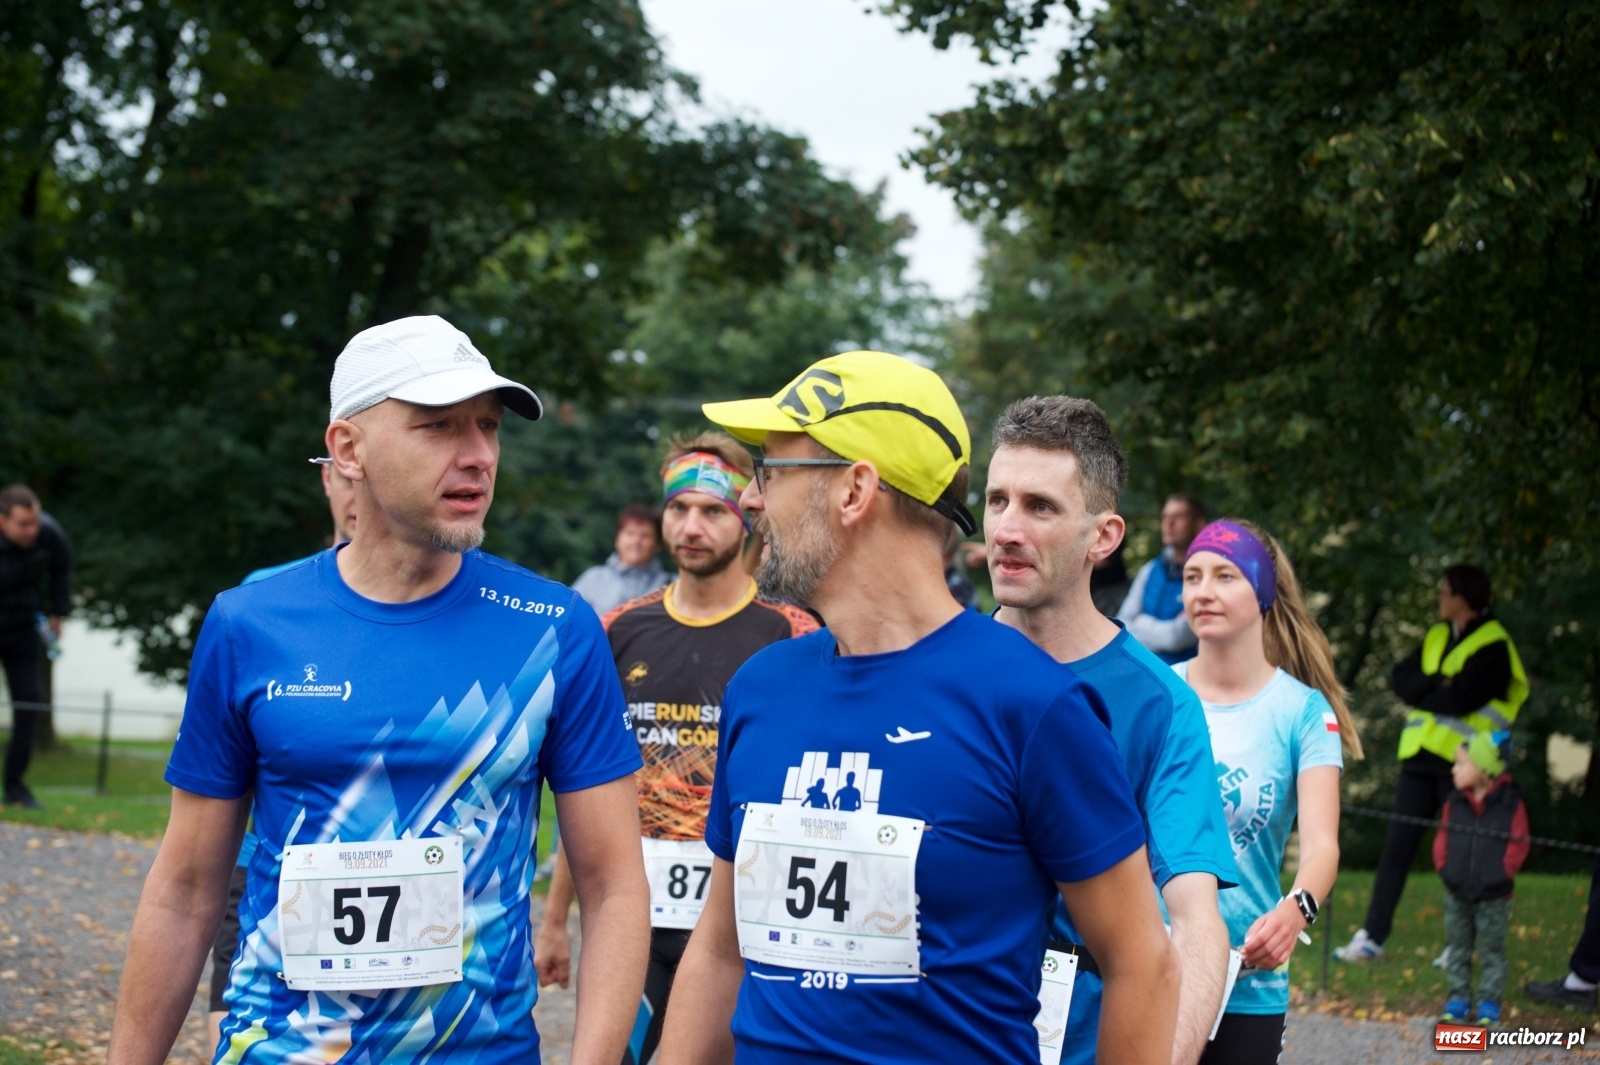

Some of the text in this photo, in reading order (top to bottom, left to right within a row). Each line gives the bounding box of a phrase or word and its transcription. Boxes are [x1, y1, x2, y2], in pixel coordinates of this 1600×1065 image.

[479, 587, 565, 617] 13.10.2019
[286, 684, 302, 692] PZU
[302, 684, 342, 692] CRACOVIA
[338, 851, 352, 861] BIEG
[357, 850, 377, 860] ZŁOTY
[376, 849, 393, 859] KŁOS
[344, 857, 388, 870] 19.09.2021
[668, 864, 712, 900] 87
[785, 856, 850, 923] 54
[333, 885, 402, 945] 57
[800, 971, 849, 990] 2019
